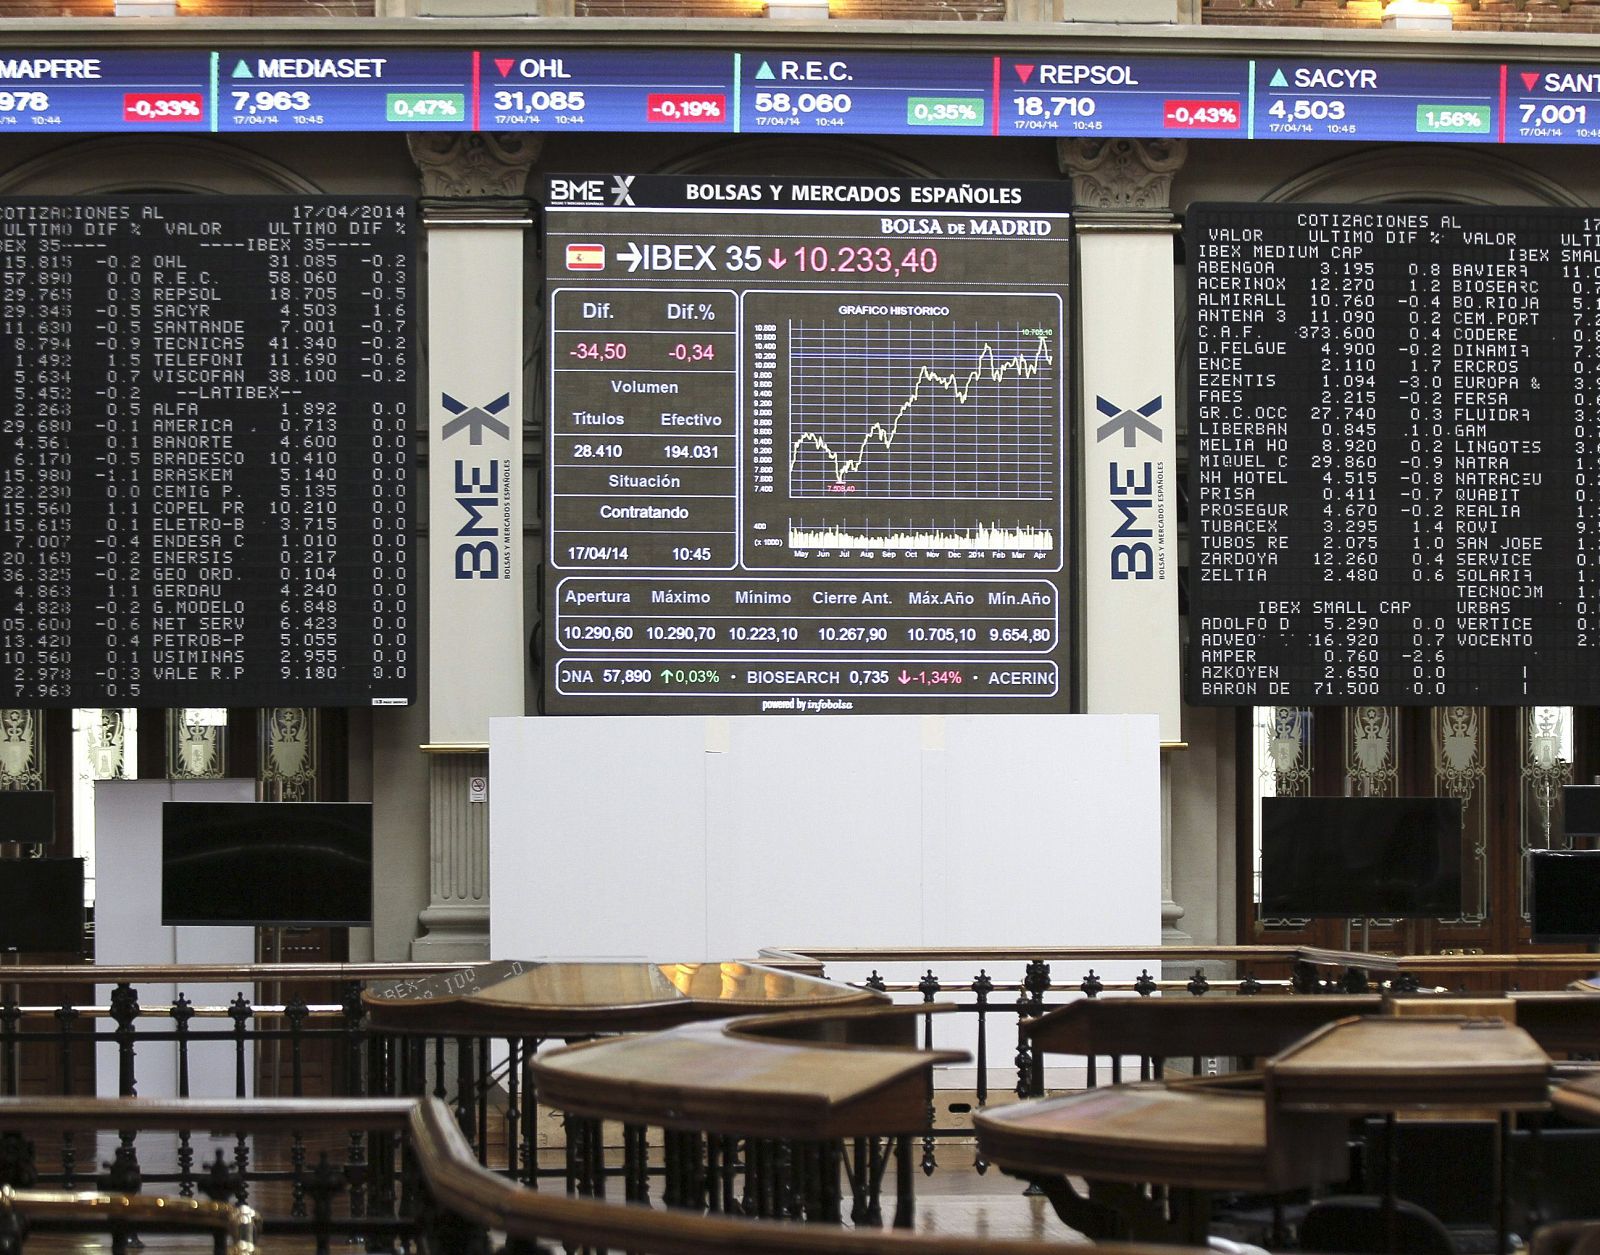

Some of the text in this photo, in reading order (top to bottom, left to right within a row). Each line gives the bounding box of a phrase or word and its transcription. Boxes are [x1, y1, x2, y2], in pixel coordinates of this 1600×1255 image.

[0, 59, 101, 78] MAPFRE
[259, 59, 387, 78] MEDIASET
[520, 59, 571, 78] OHL
[782, 61, 852, 80] R.E.C.
[1041, 65, 1138, 84] REPSOL
[1295, 69, 1377, 88] SACYR
[127, 101, 199, 118] -0,33%
[232, 92, 456, 117] 7,963 0,47%
[495, 92, 720, 118] 31,085 -0,19%
[755, 93, 976, 121] 58,060 0,35%
[1014, 97, 1236, 124] 18,710 -0,43%
[31, 115, 62, 125] 10:44
[233, 115, 324, 125] 17/04/14 10:45
[1269, 100, 1481, 128] 4,503 1,56%
[1520, 105, 1585, 126] 7,001
[1013, 120, 1103, 130] 17/04/14 10:45
[1519, 127, 1563, 137] 17/04/14
[551, 180, 604, 200] BME
[687, 184, 1021, 204] BOLSAS Y MERCADOS ESPAÑOLES
[143, 206, 405, 219] AL 17/04/2014
[881, 219, 1051, 235] BOLSA DE MADRID
[1298, 214, 1461, 228] COTIZACIONES AL
[85, 223, 117, 235] DIF
[166, 222, 221, 235] VALOR
[269, 222, 336, 234] ULTIMO
[350, 222, 382, 234] DIF
[1209, 229, 1516, 245] VALOR ULTIMO DIF VALOR
[1200, 245, 1362, 258] IBEX MEDIUM CAP
[154, 255, 336, 268] OHL 31.085
[644, 245, 937, 277] IBEX 35 10.233,40
[1199, 261, 1373, 275] ABENGOA 3.195
[154, 271, 405, 284] R.E.C. 58.060 0.3
[1199, 277, 1374, 291] ACERINOX 12.270
[154, 288, 221, 300] REPSOL
[1199, 293, 1374, 307] ALMIRALL 10.760
[154, 304, 405, 317] SACYR 4.503 1.6
[584, 303, 715, 320] Dif. Dif.%
[154, 321, 244, 333] SANTANDE
[154, 337, 244, 349] TECNICAS
[1199, 342, 1286, 354] D.FELGUE
[570, 343, 714, 362] -34,50 -0,34
[1200, 358, 1518, 372] ENCE ERCROS
[154, 370, 244, 382] VISCOFAN
[611, 381, 678, 393] Volumen
[1200, 390, 1507, 405] FAES FERSA
[154, 402, 405, 415] ALFA 0.0
[573, 412, 721, 425] Títulos Efectivo
[1200, 423, 1287, 435] LIBERBAN
[154, 452, 244, 464] BRADESCO
[574, 445, 717, 458] 28.410 194.031
[502, 459, 511, 501] ESPAÑOLES
[609, 474, 680, 487] Situación
[1156, 461, 1164, 502] ESPAÑOLES
[1201, 488, 1519, 501] PRISA 0.411 QUABIT
[600, 505, 688, 518] Contratando
[1201, 504, 1519, 517] PROSEGUR REALIA
[455, 460, 498, 579] BME
[503, 502, 511, 544] MERCADOS
[1110, 462, 1153, 579] BME
[1157, 503, 1165, 545] MERCADOS
[1201, 520, 1496, 533] TUBACEX 3.295 1.4 ROVI
[154, 551, 232, 563] ENERSIS
[569, 547, 711, 560] 17/04/14 10:45
[1202, 553, 1277, 564] ZARDOYA
[1158, 552, 1166, 580] BOLSAS
[1202, 569, 1266, 581] ZELTIA
[154, 585, 220, 597] GERDAU
[566, 590, 1050, 605] Apertura Máximo Mínimo Cierre Ant. Máx.Año Mín.Año
[1259, 602, 1510, 613] IBEX SMALL CAP URBAS
[564, 626, 1050, 643] 10.290,60 10.290,70 10.223,10 10.267,90 10.705,10 9.654,80
[154, 650, 406, 663] USIMINAS 2.955 0.0
[1202, 650, 1378, 662] AMPER 0.760
[604, 670, 651, 684] 57,890
[676, 670, 719, 684] 0,03%
[748, 671, 839, 683] BIOSEARCH
[850, 671, 889, 685] 0,735
[913, 671, 961, 685] -1,34%
[1203, 666, 1278, 678] AZKOYEN
[762, 697, 853, 712] powered by infobolsa
